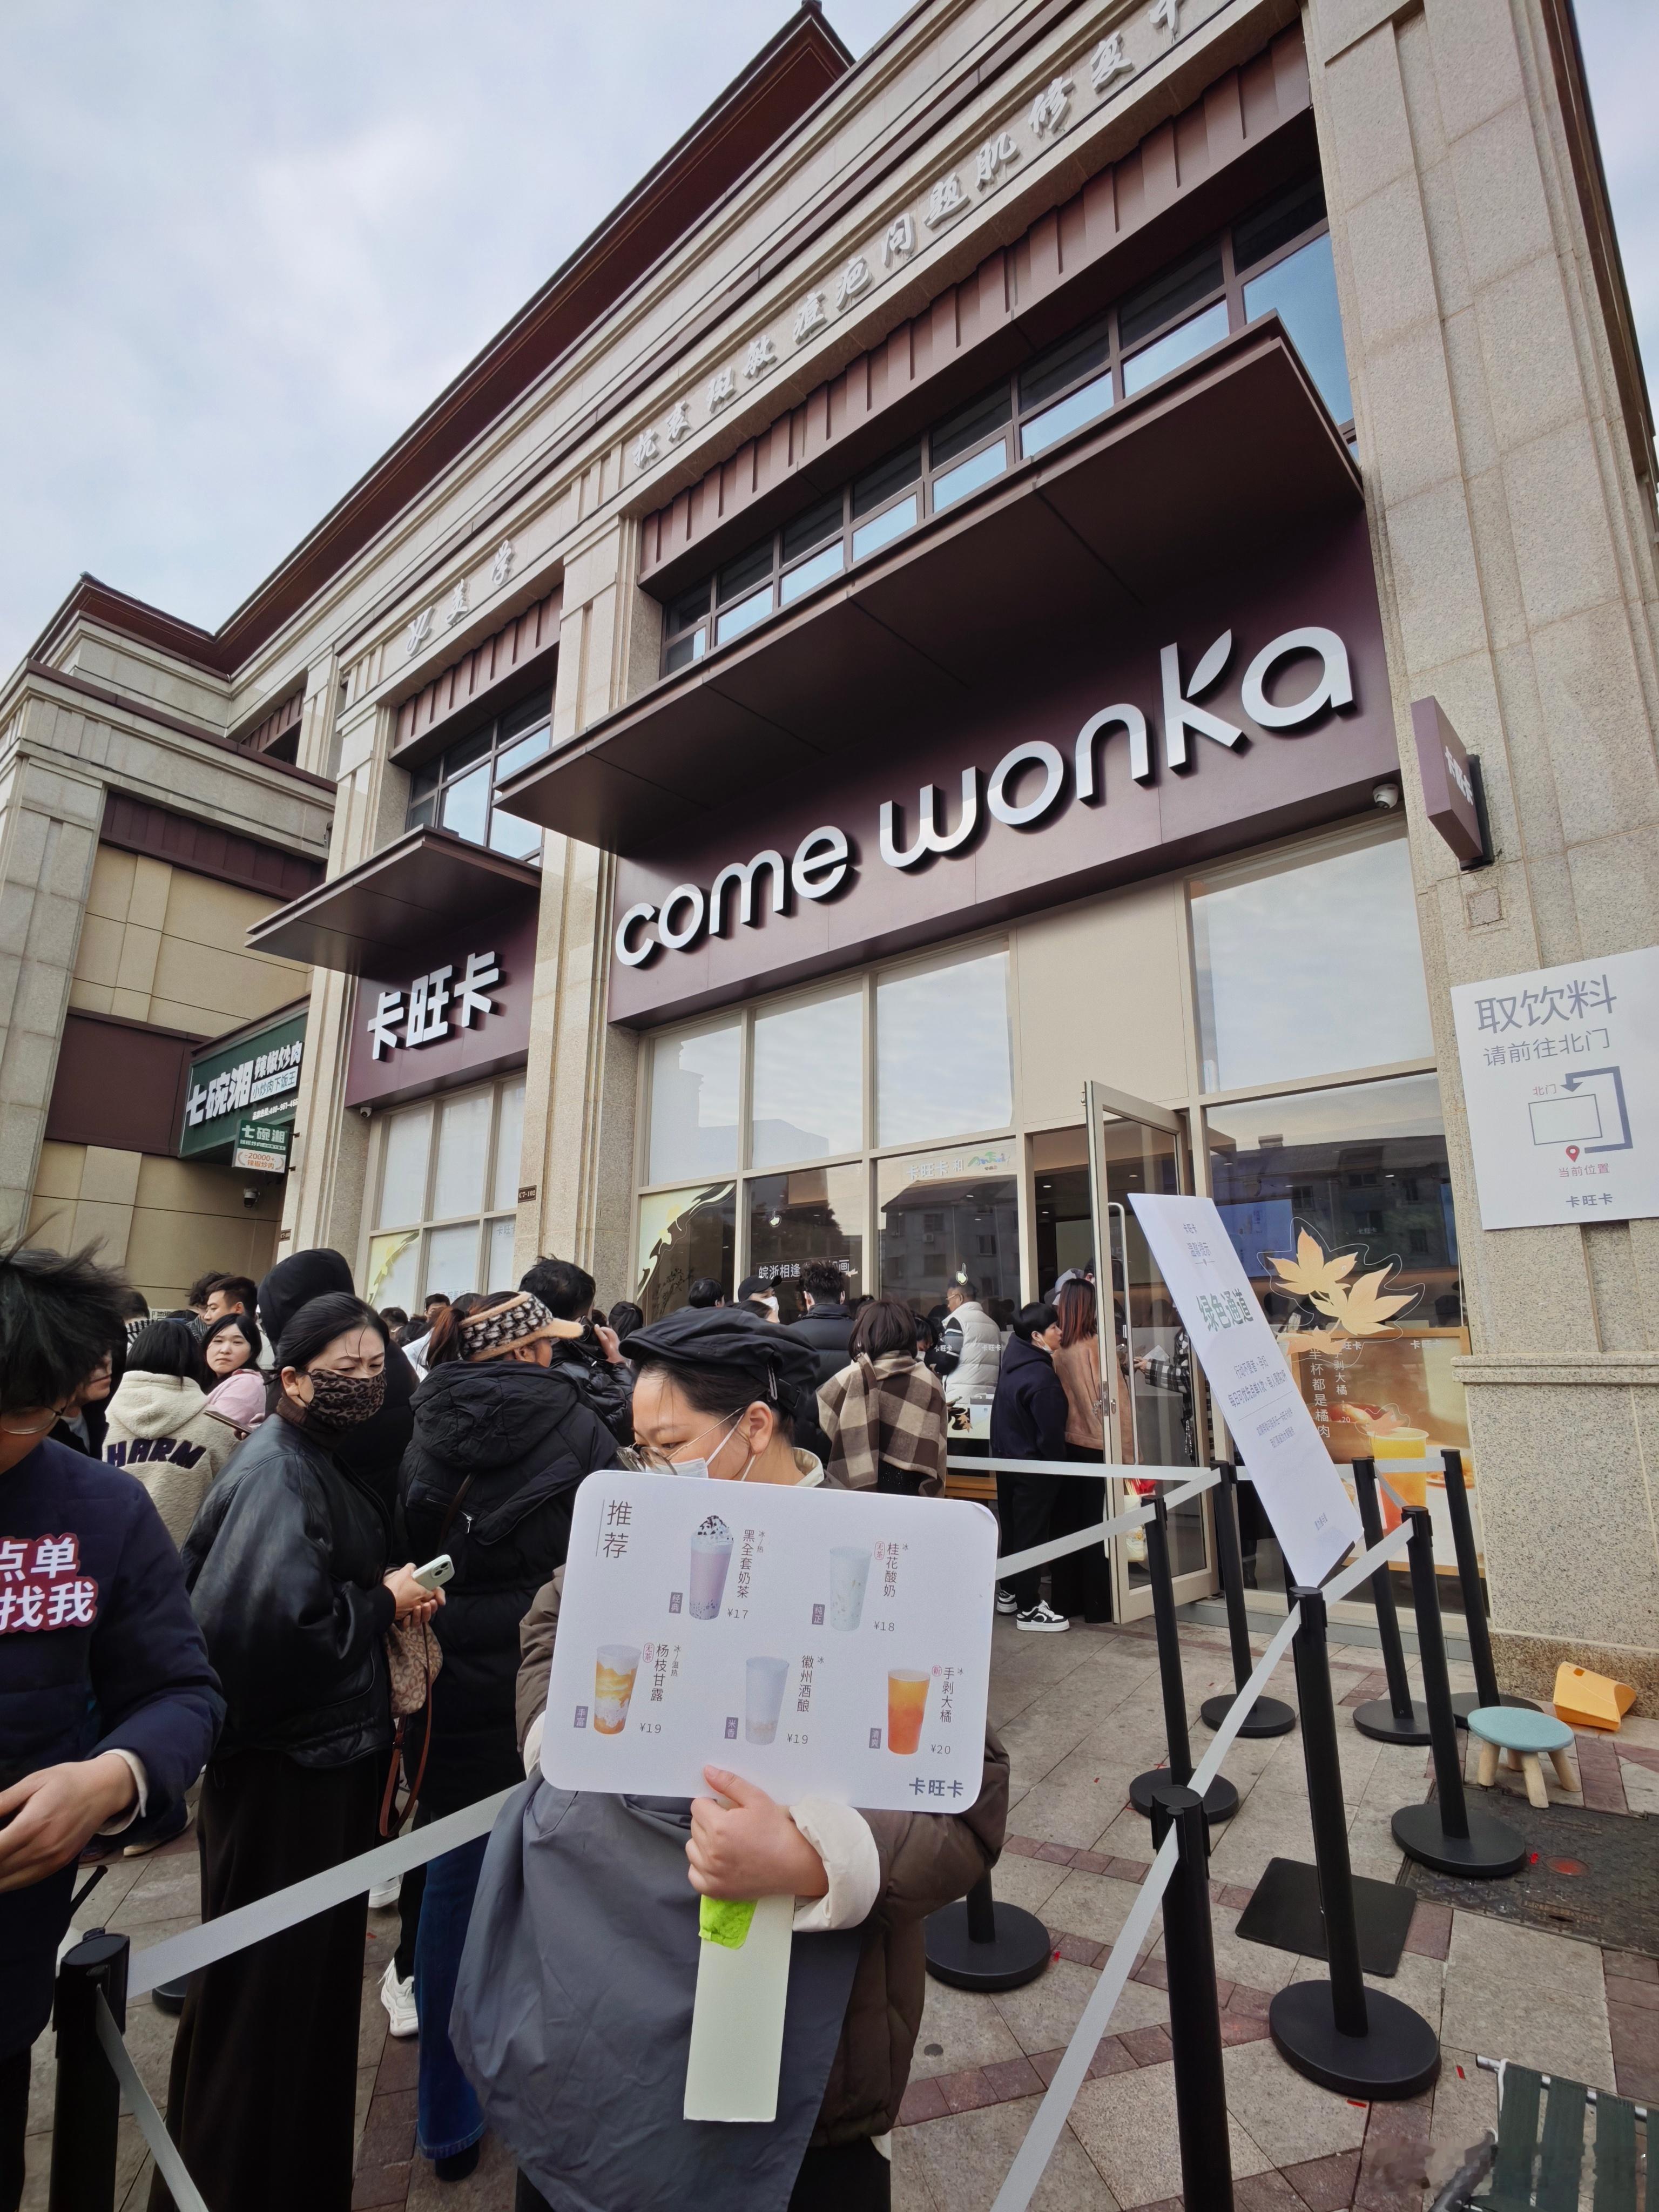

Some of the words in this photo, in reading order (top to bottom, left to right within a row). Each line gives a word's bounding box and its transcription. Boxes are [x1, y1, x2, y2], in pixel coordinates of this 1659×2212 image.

[615, 825, 849, 967] come
[879, 626, 1355, 868] wonka
[368, 951, 499, 1060] 卡旺卡
[1475, 974, 1617, 1034] 取饮料
[1483, 1028, 1610, 1067] 请前往北门
[254, 1041, 302, 1080] 辣椒炒肉
[186, 1060, 254, 1127] 七碗湘
[253, 1070, 296, 1099] 小炒肉下饭王
[1532, 1084, 1557, 1096] 北门
[241, 1125, 285, 1143] 七碗湘
[907, 1161, 949, 1180] 卡旺卡
[953, 1158, 964, 1172] 和
[1559, 1163, 1610, 1178] 当前位置
[1566, 1192, 1613, 1208] 卡旺卡
[758, 1263, 801, 1279] 皖浙相逢
[1196, 1288, 1253, 1332] 绿色通道
[934, 1344, 953, 1352] 卡旺卡
[1343, 1341, 1361, 1350] 旺卡
[1309, 1349, 1330, 1437] 半杯都是橘肉
[107, 1438, 207, 1469] HARM
[603, 1500, 632, 1559] 推荐
[902, 1543, 908, 1551] 冰
[0, 1537, 76, 1582] 点单
[737, 1529, 755, 1599] 黑全套奶茶
[884, 1542, 899, 1597] 桂花酸奶
[0, 1581, 94, 1630] 找我
[671, 1594, 682, 1612] 经典
[727, 1608, 749, 1619] ¥17
[814, 1606, 823, 1623] 纯正
[874, 1621, 895, 1631] ¥18
[650, 1643, 669, 1702] 杨枝甘露
[797, 1655, 814, 1712] 徽州酒酿
[940, 1667, 954, 1723] 手剥大橘
[576, 1708, 586, 1727] 丰富
[640, 1722, 662, 1734] ¥19
[727, 1719, 736, 1737] 米香
[787, 1733, 808, 1744] ¥19
[931, 1744, 951, 1755] ¥20
[909, 1777, 964, 1798] 卡旺卡
